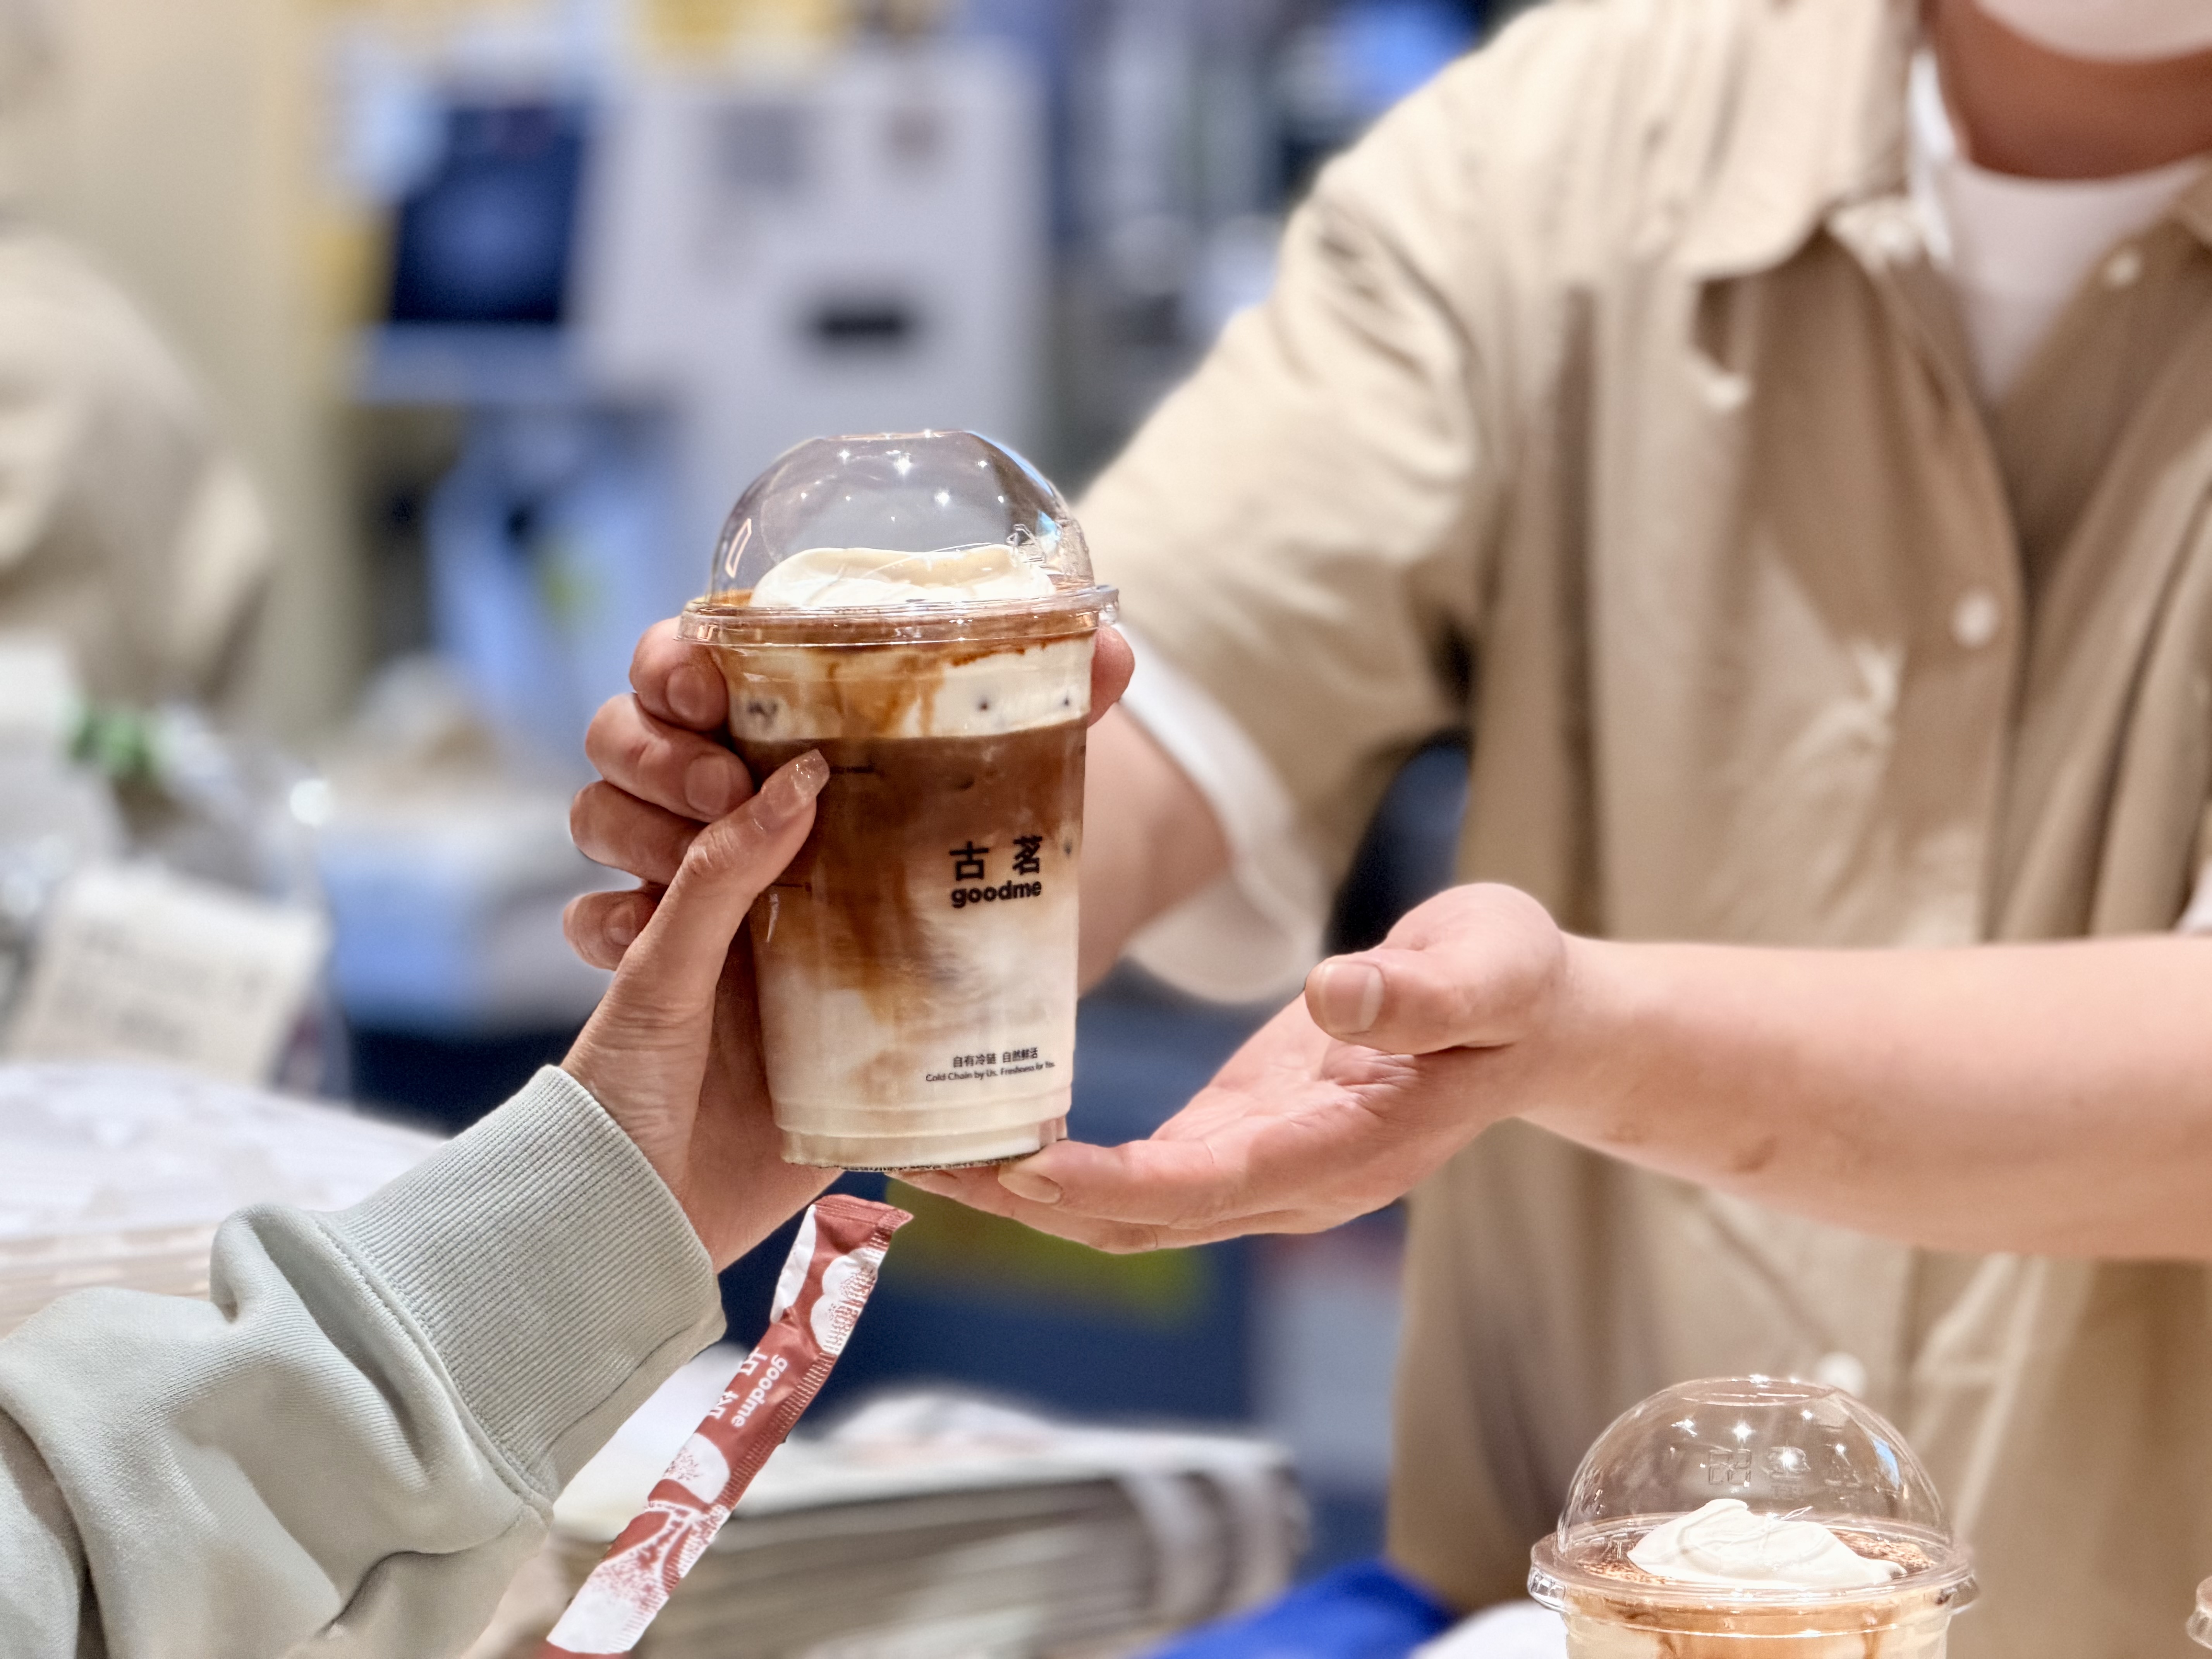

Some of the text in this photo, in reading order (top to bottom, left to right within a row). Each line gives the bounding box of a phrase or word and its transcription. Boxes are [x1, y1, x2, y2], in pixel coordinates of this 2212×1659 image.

[949, 835, 1042, 881] 古茗
[951, 880, 1042, 908] goodme
[926, 1073, 946, 1082] Cold
[948, 1071, 972, 1080] Chain
[974, 1071, 984, 1080] by
[731, 1354, 788, 1427] goodme
